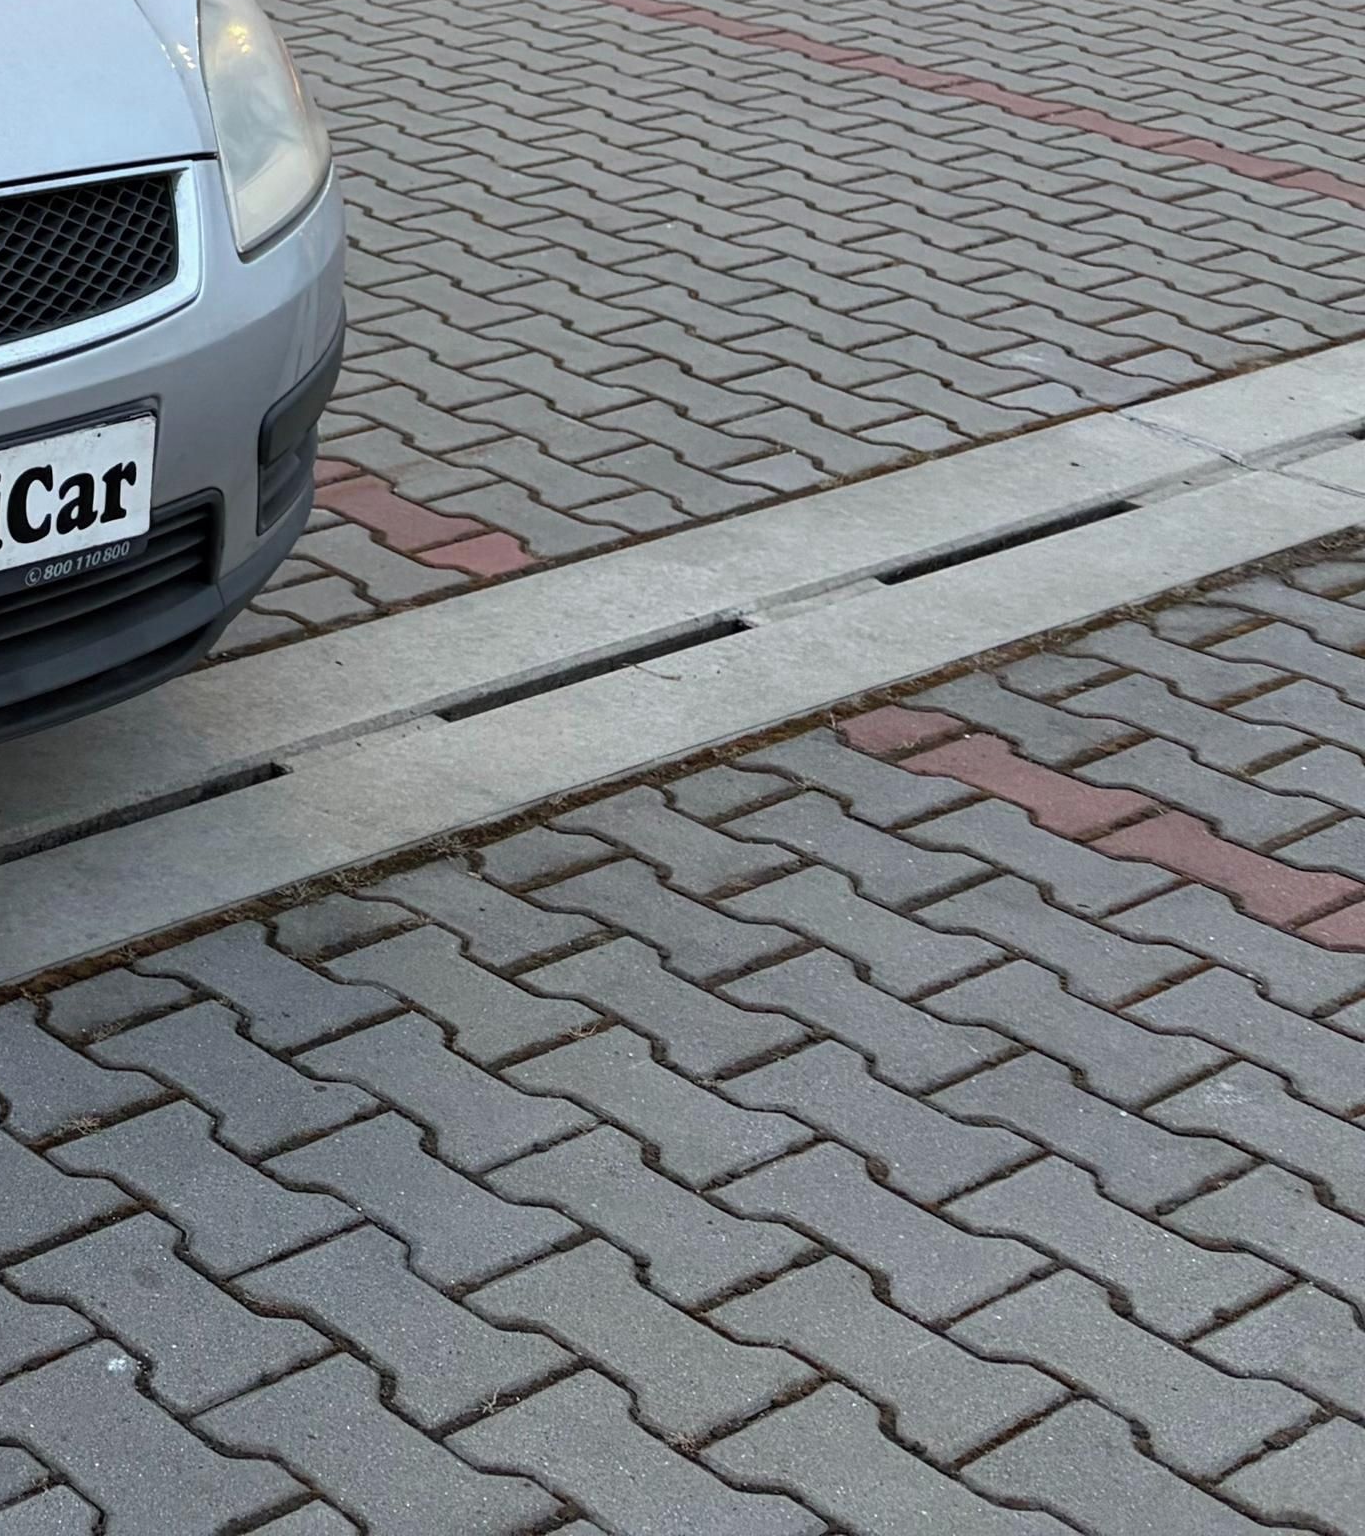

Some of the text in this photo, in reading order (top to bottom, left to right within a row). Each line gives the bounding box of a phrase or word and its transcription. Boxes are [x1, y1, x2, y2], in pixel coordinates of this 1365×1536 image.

[43, 541, 130, 581] 800 110 800
